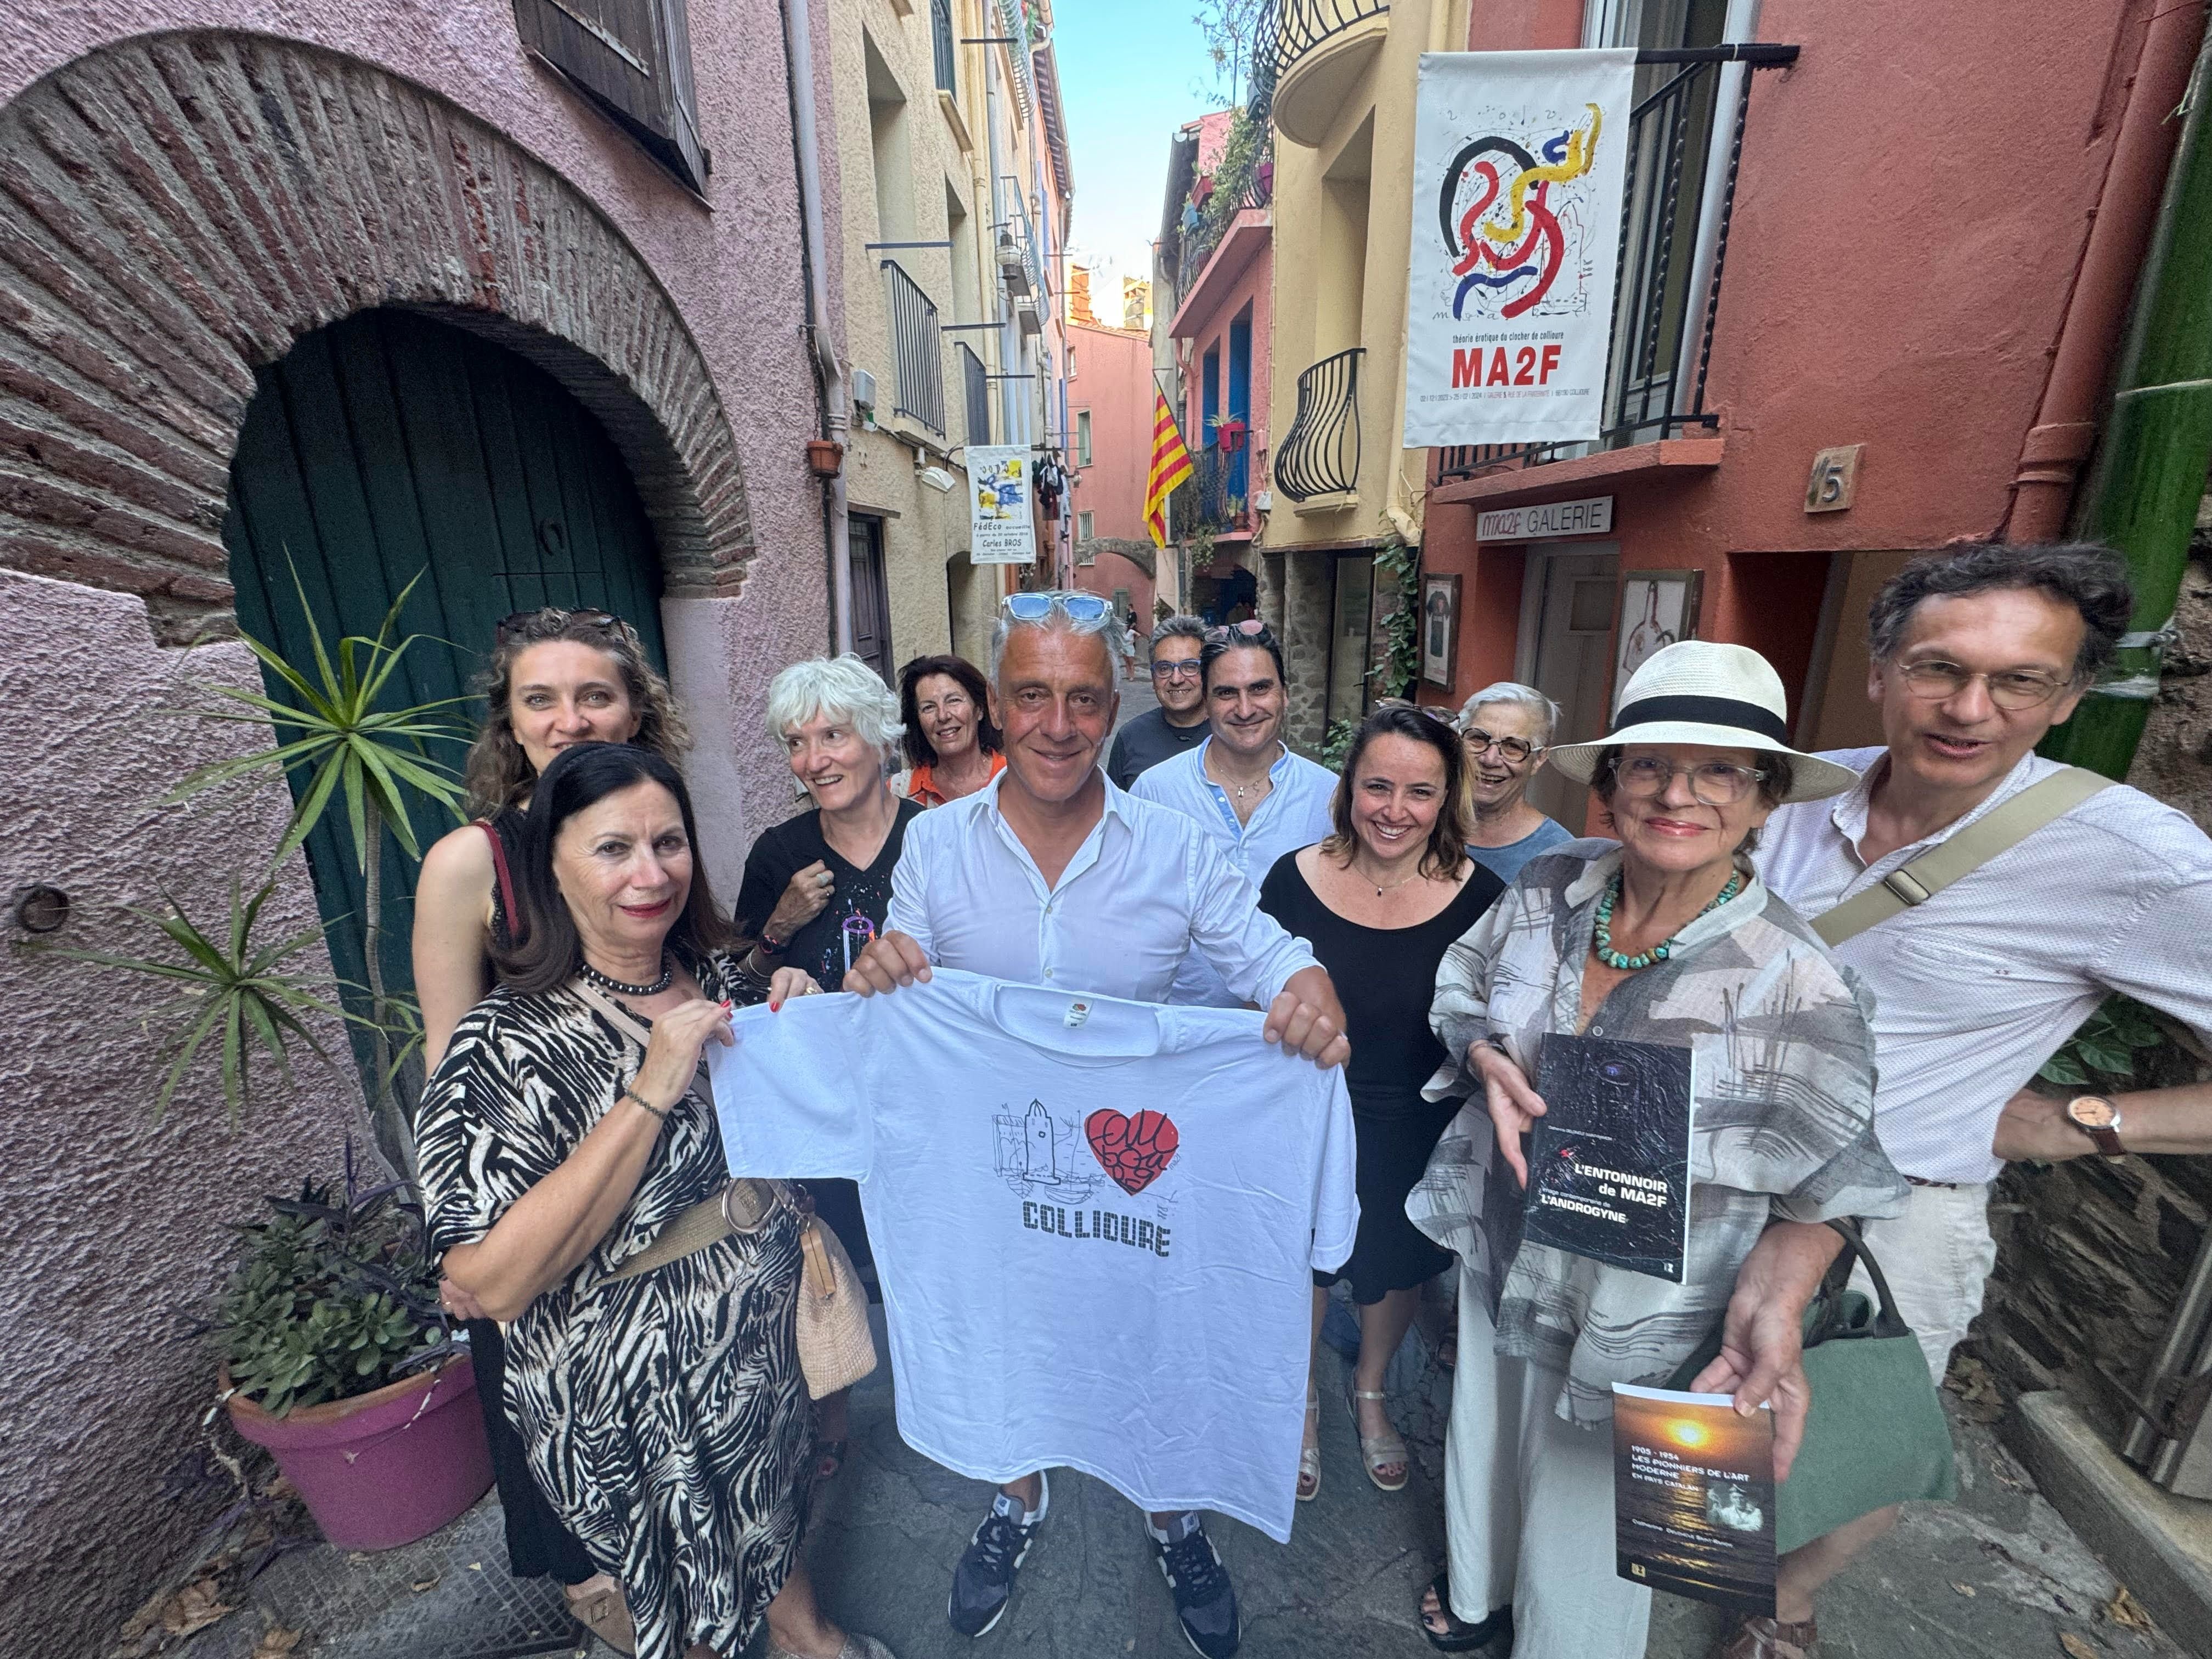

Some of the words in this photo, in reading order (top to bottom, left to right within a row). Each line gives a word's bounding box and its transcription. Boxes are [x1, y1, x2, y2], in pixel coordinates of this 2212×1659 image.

[1453, 333, 1473, 343] théorie
[1475, 332, 1498, 343] érotique
[1500, 332, 1507, 341] du
[1509, 332, 1530, 340] clocher
[1531, 331, 1538, 340] de
[1540, 331, 1564, 339] collioure
[1452, 345, 1562, 388] MA2F
[974, 522, 1002, 531] FédEco
[1527, 503, 1602, 533] GALERIE
[983, 539, 1002, 548] Carles
[1575, 1163, 1668, 1193] L'ENTONNOIR
[1599, 1183, 1616, 1196] de
[1620, 1187, 1667, 1207] MA2F
[1541, 1194, 1627, 1223] L'ANDROGYNE
[1023, 1201, 1171, 1257] COLLIOURE
[1632, 1445, 1652, 1455] 1905
[1632, 1454, 1651, 1464] LES
[1652, 1458, 1705, 1475] PIONNIERS
[1707, 1468, 1722, 1478] DE
[1723, 1471, 1750, 1482] L'ART
[1632, 1463, 1680, 1480] MODERNE
[1632, 1472, 1643, 1480] EN
[1644, 1475, 1663, 1485] PAYS
[1664, 1480, 1700, 1492] CATALAN
